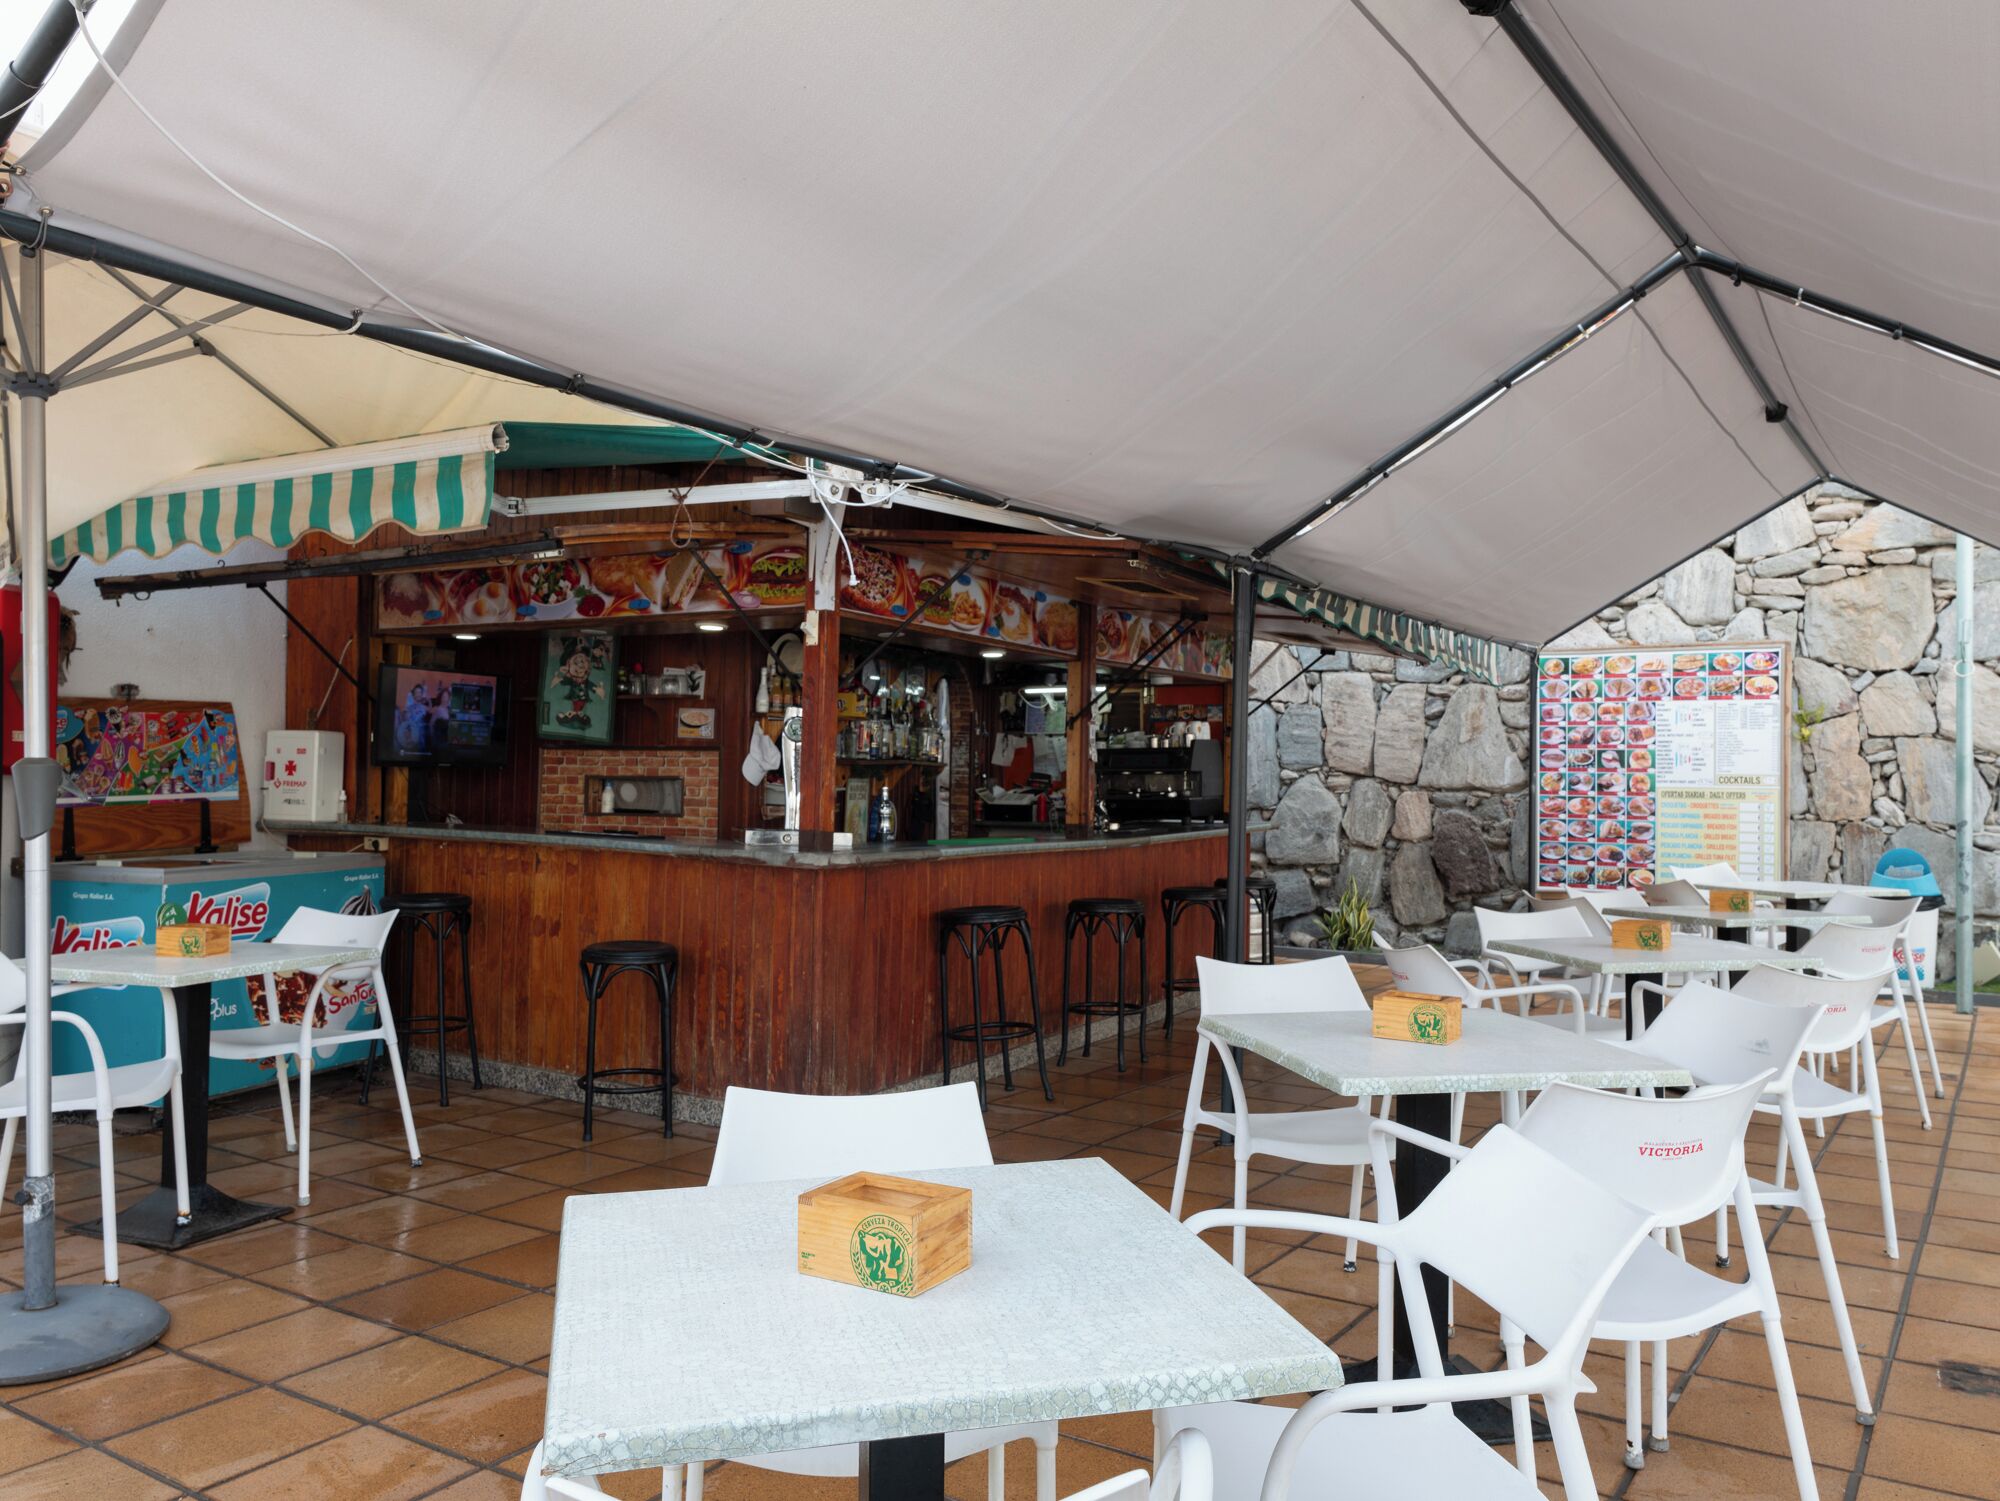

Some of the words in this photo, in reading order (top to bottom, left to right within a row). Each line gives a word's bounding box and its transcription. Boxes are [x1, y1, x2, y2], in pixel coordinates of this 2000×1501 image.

[1718, 775, 1761, 785] COCKTAILS
[1709, 791, 1724, 799] DAILY
[1725, 791, 1746, 800] OFFERS
[187, 893, 268, 927] Kalise
[51, 916, 138, 956] Kali
[1639, 1143, 1704, 1156] VICTORIA
[861, 1217, 885, 1231] CERVEZA
